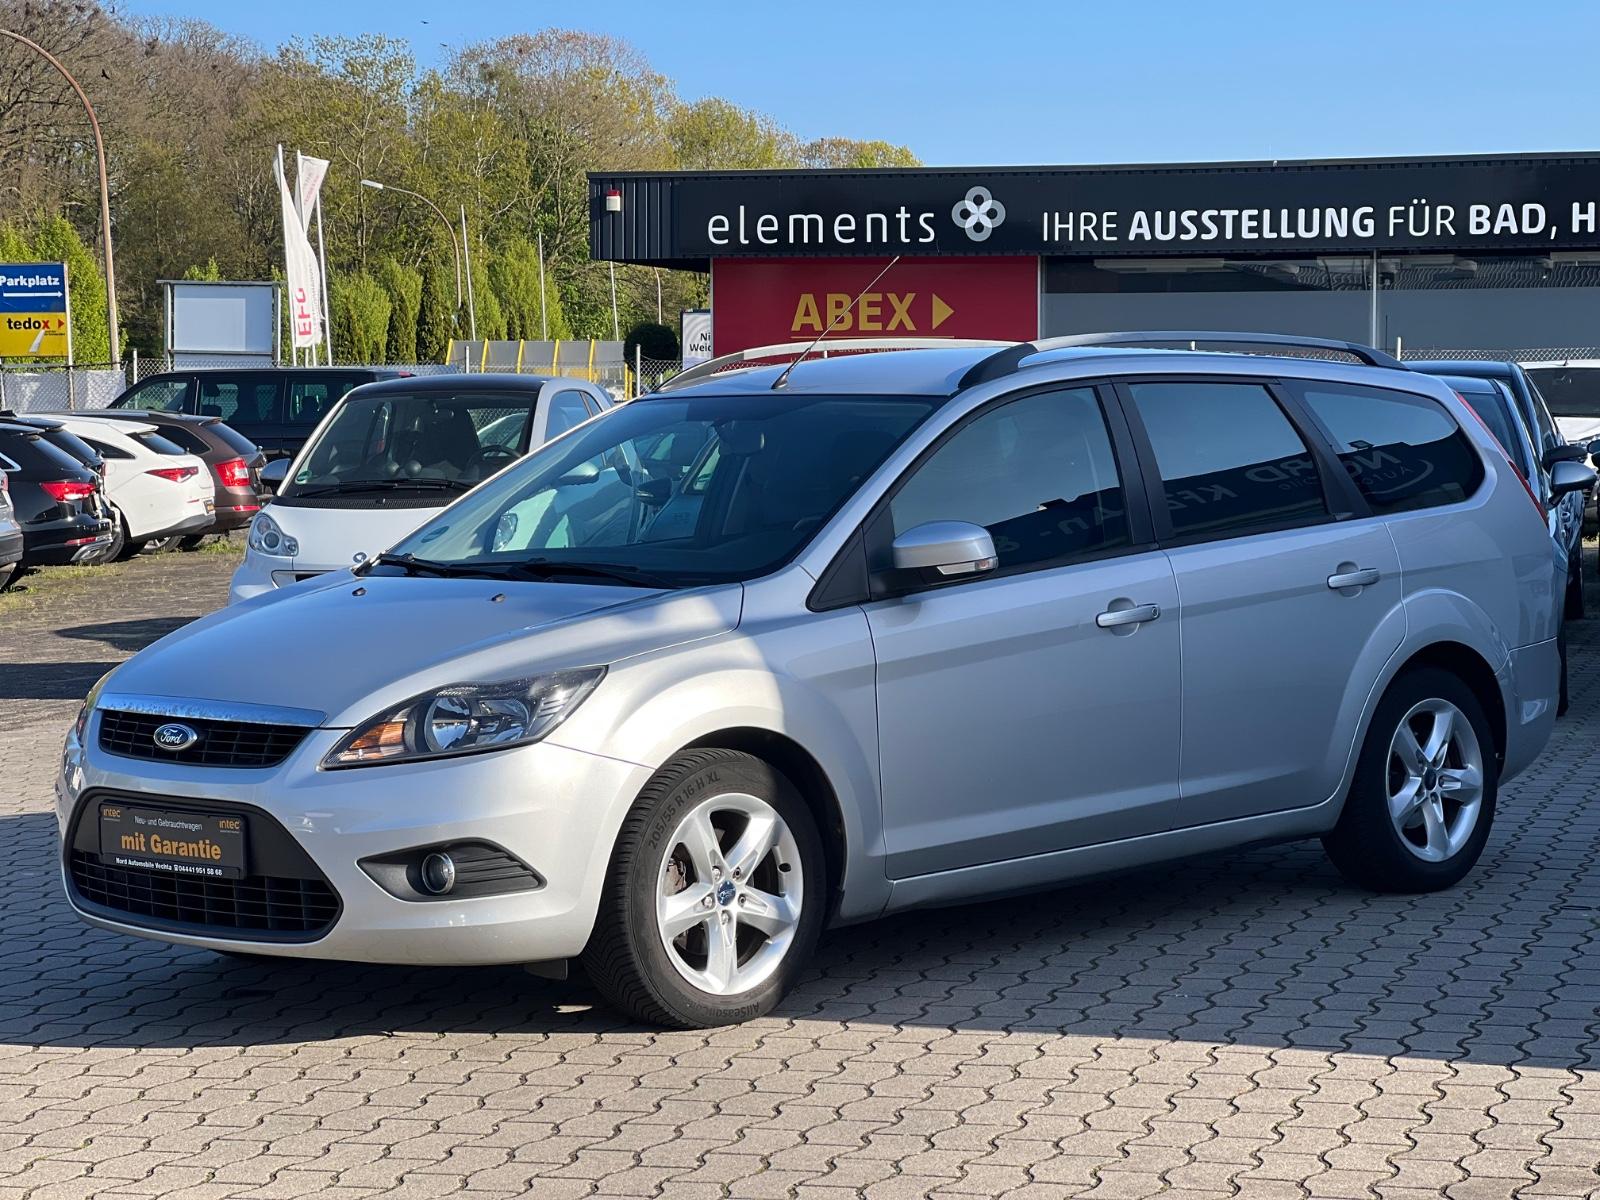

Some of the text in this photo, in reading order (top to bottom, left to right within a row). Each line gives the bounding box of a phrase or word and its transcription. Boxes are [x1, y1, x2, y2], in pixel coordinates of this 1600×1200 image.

[707, 205, 935, 245] elements
[1042, 211, 1118, 242] IHRE
[1127, 206, 1376, 242] AUSSTELLUNG
[1388, 198, 1457, 238] FÜR
[1468, 202, 1558, 240] BAD,
[0, 275, 60, 288] Parkplatz
[790, 292, 918, 332] ABEX
[7, 317, 51, 330] tedox
[160, 728, 183, 744] Ford
[103, 808, 121, 818] intec
[648, 770, 721, 850] 205/55 R 16 H XL
[148, 817, 158, 826] und
[157, 818, 203, 832] Gebrauchtwagen
[219, 819, 241, 830] intec
[121, 832, 222, 860] mit Garantie
[115, 857, 128, 865] Nord
[128, 859, 155, 869] Automobile
